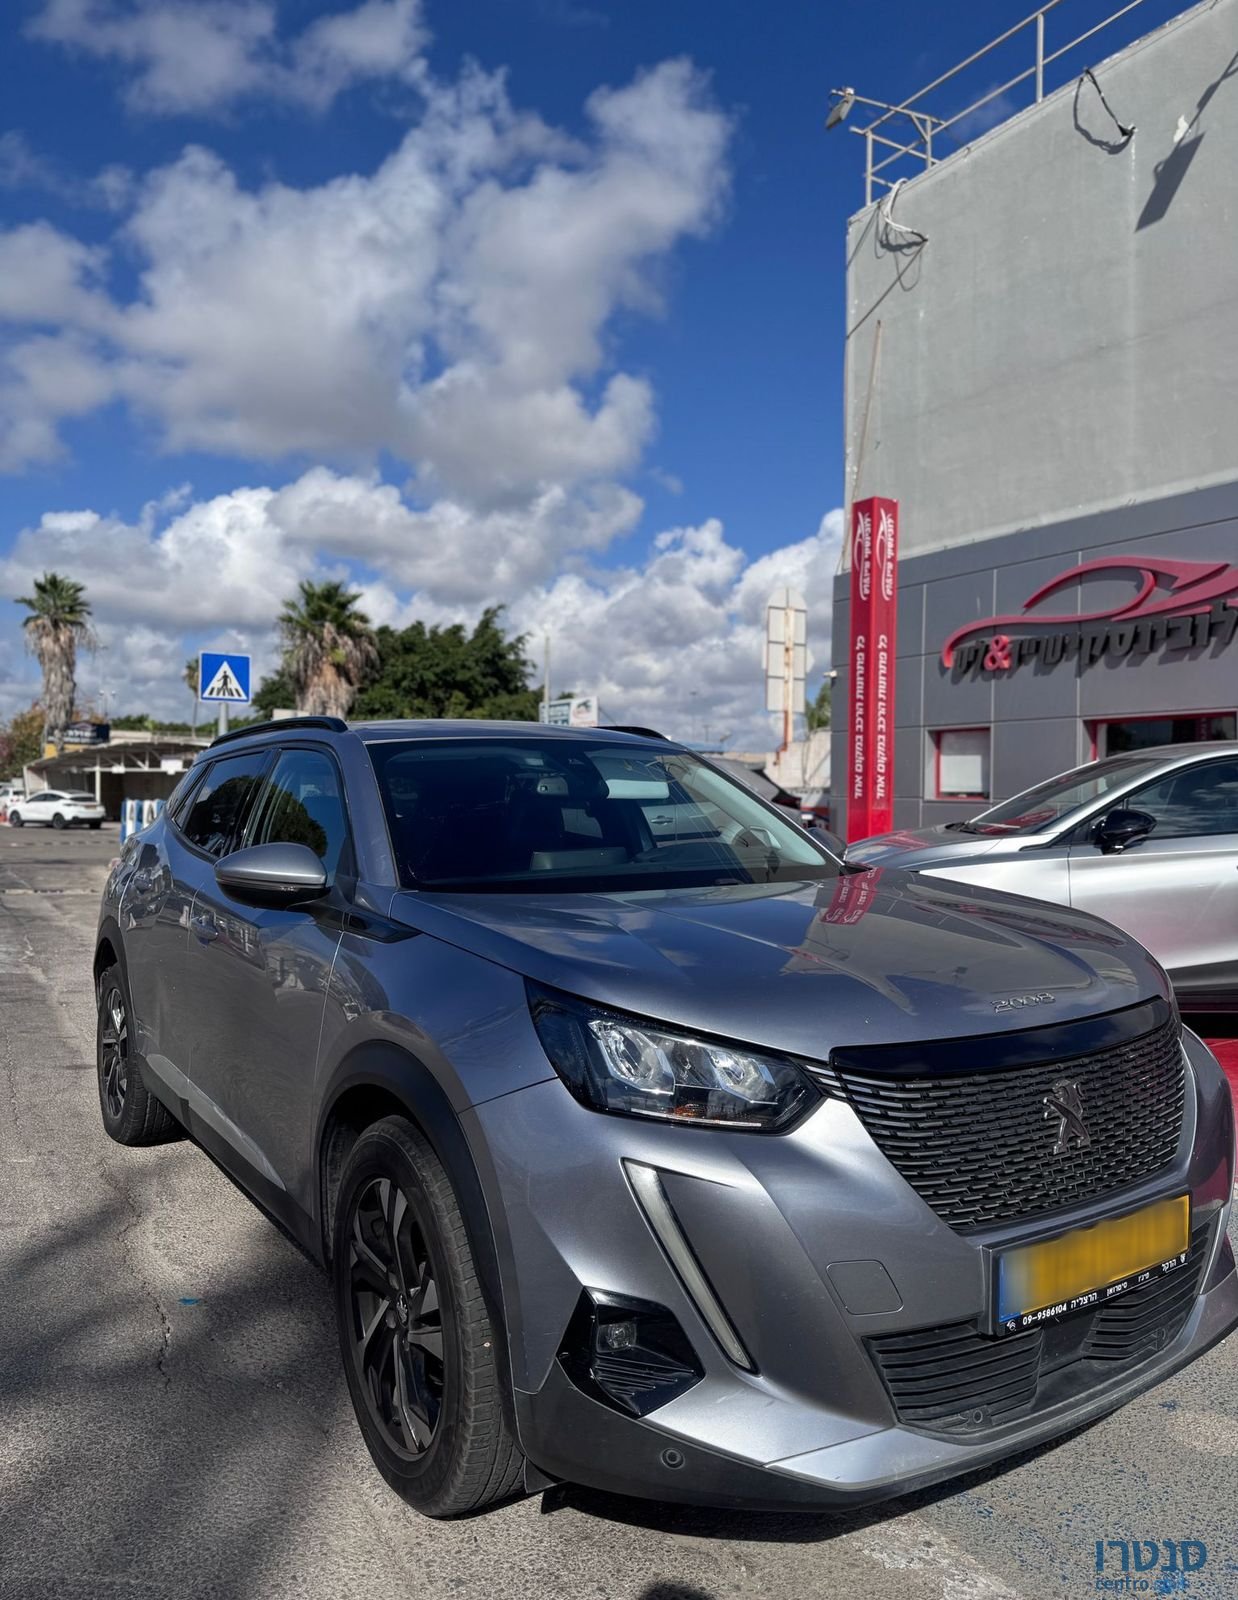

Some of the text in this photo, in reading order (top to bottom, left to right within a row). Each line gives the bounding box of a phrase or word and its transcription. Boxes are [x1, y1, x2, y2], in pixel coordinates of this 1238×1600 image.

[1066, 598, 1238, 664] לובינסקי
[854, 635, 865, 799] כל פתרונות הרכב במקום אחד
[875, 634, 888, 799] כל פתרונות הרכב במקום אחד
[991, 992, 1056, 1013] 2008
[1022, 1303, 1067, 1326] 09-9586104
[1070, 1292, 1097, 1309] הרצליה
